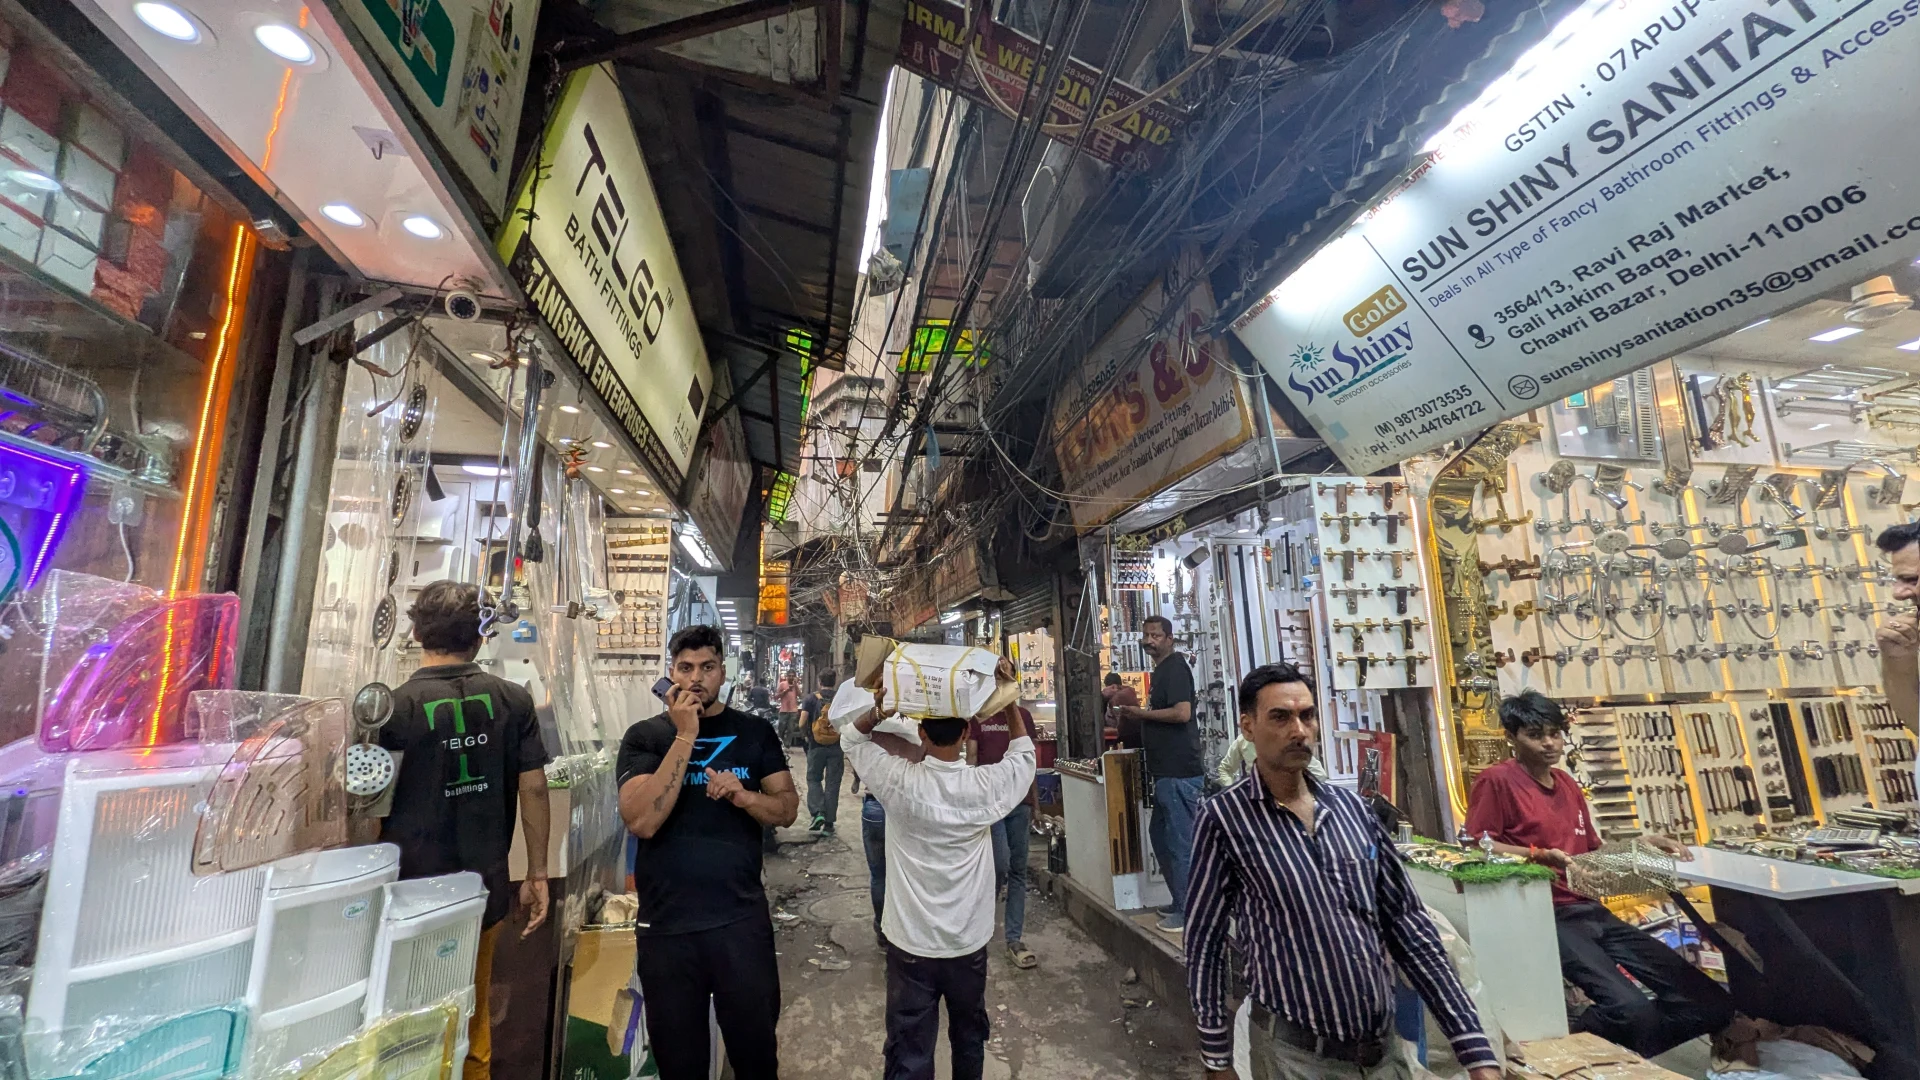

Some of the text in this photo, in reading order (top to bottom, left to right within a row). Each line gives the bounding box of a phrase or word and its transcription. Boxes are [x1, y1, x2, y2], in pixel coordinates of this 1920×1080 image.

[1504, 93, 1575, 152] GSTIN
[1596, 0, 1716, 82] 07APUP
[575, 122, 664, 345] TELGO
[1402, 226, 1469, 282] SUN
[1466, 142, 1579, 237] SHINY
[1427, 281, 1463, 308] Deals
[1460, 272, 1477, 288] in
[1476, 260, 1496, 280] All
[1492, 241, 1531, 265] Type
[1532, 225, 1548, 244] of
[1548, 197, 1599, 233] Fancy
[1599, 140, 1695, 201] Bathroom
[1696, 82, 1787, 143] Fittings
[1790, 66, 1818, 84] &
[1493, 165, 1791, 324] 3564/13, Ravi Raj Market,
[564, 212, 643, 360] BATH FITTINGS
[1348, 289, 1404, 333] Gold
[1507, 246, 1692, 339] Gali Hakim Baqa,
[1519, 185, 1867, 355] Chawri Bazar, Delhi-110006
[525, 257, 650, 448] TANISHKA ENTERPRISES
[1334, 359, 1413, 406] bathroom accessories
[1374, 384, 1473, 438] (M) 9873073535
[1395, 399, 1486, 445] 011-44764722
[442, 733, 488, 750] TELGO
